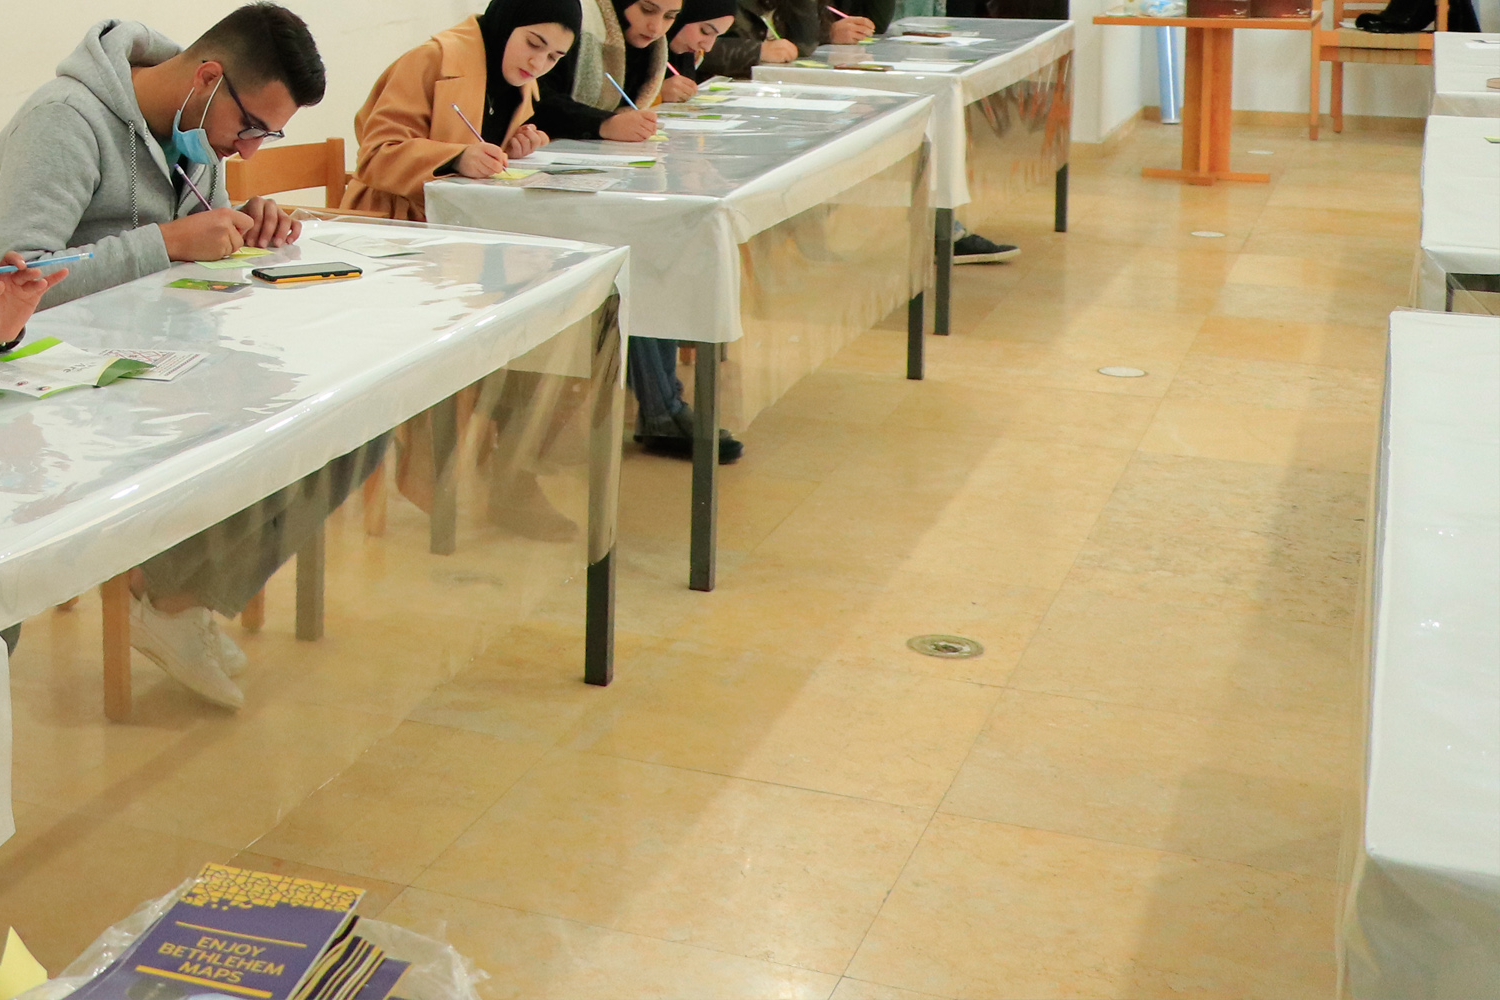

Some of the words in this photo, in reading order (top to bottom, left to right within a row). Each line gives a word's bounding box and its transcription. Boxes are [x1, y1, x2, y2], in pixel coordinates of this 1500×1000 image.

[196, 936, 266, 957] ENJOY
[158, 942, 285, 976] BETHLEHEM
[178, 961, 244, 983] MAPS
